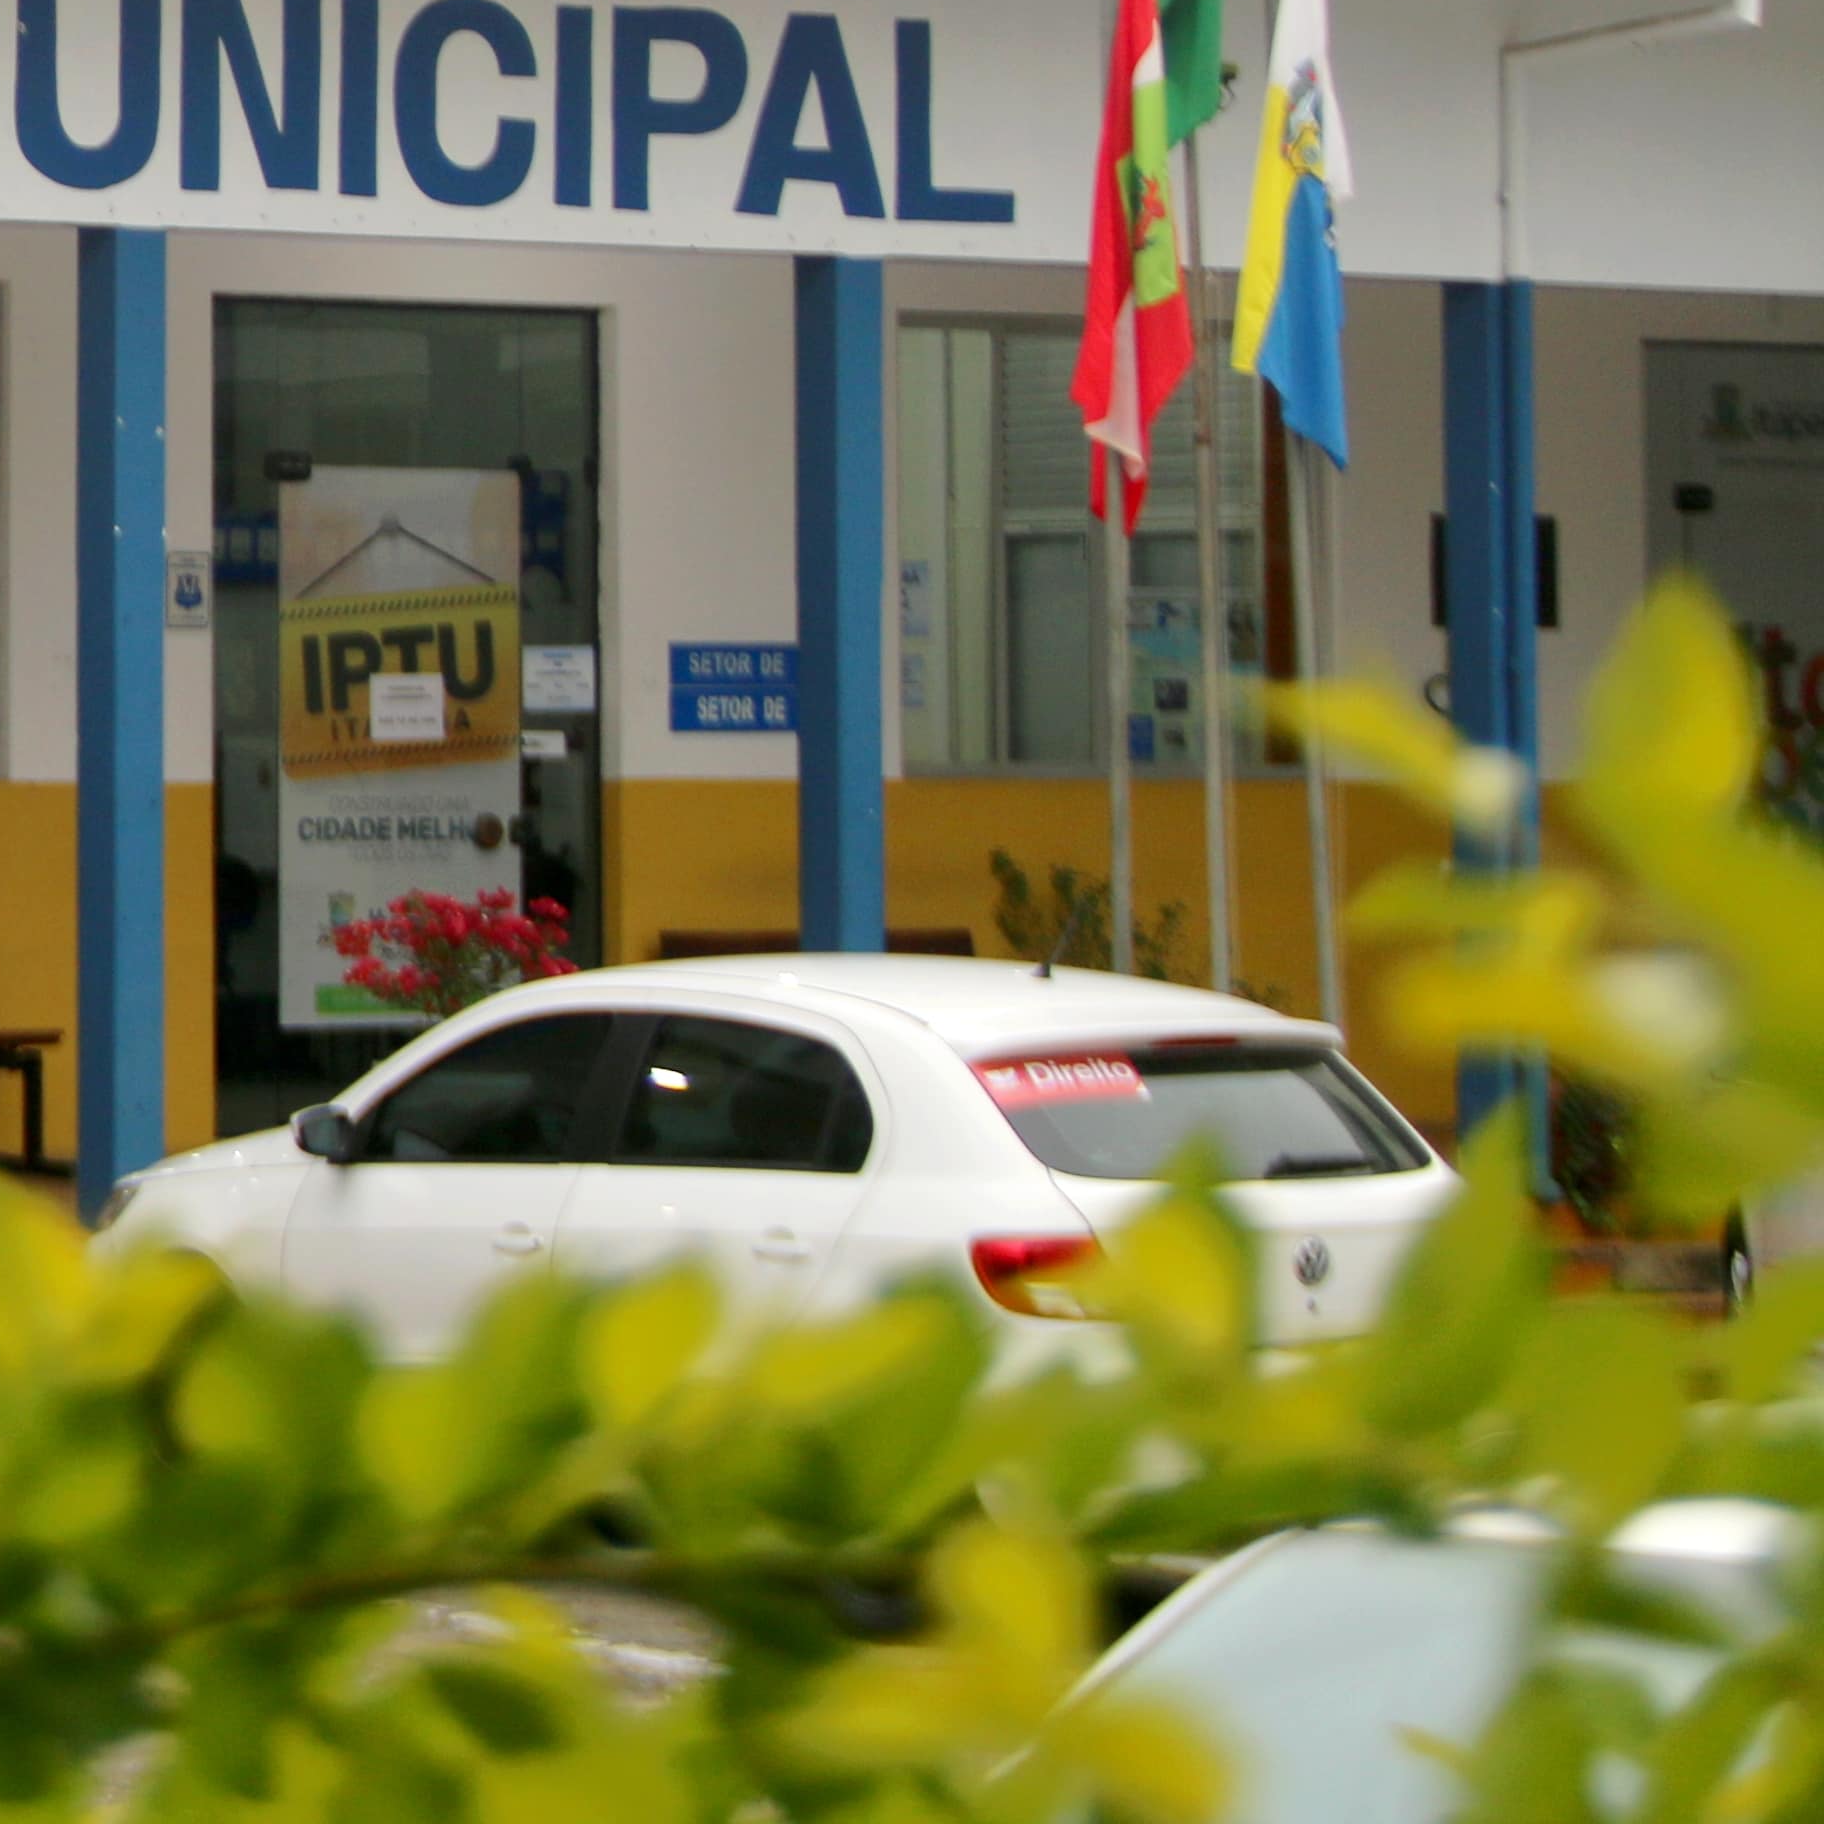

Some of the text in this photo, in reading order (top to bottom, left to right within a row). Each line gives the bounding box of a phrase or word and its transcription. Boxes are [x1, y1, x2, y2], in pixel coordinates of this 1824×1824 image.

[302, 619, 494, 715] IPTU
[688, 651, 785, 676] SETOR DE
[696, 695, 787, 722] SETOR DE
[297, 815, 476, 841] CIDADE MELH
[1023, 1056, 1134, 1090] Direito
